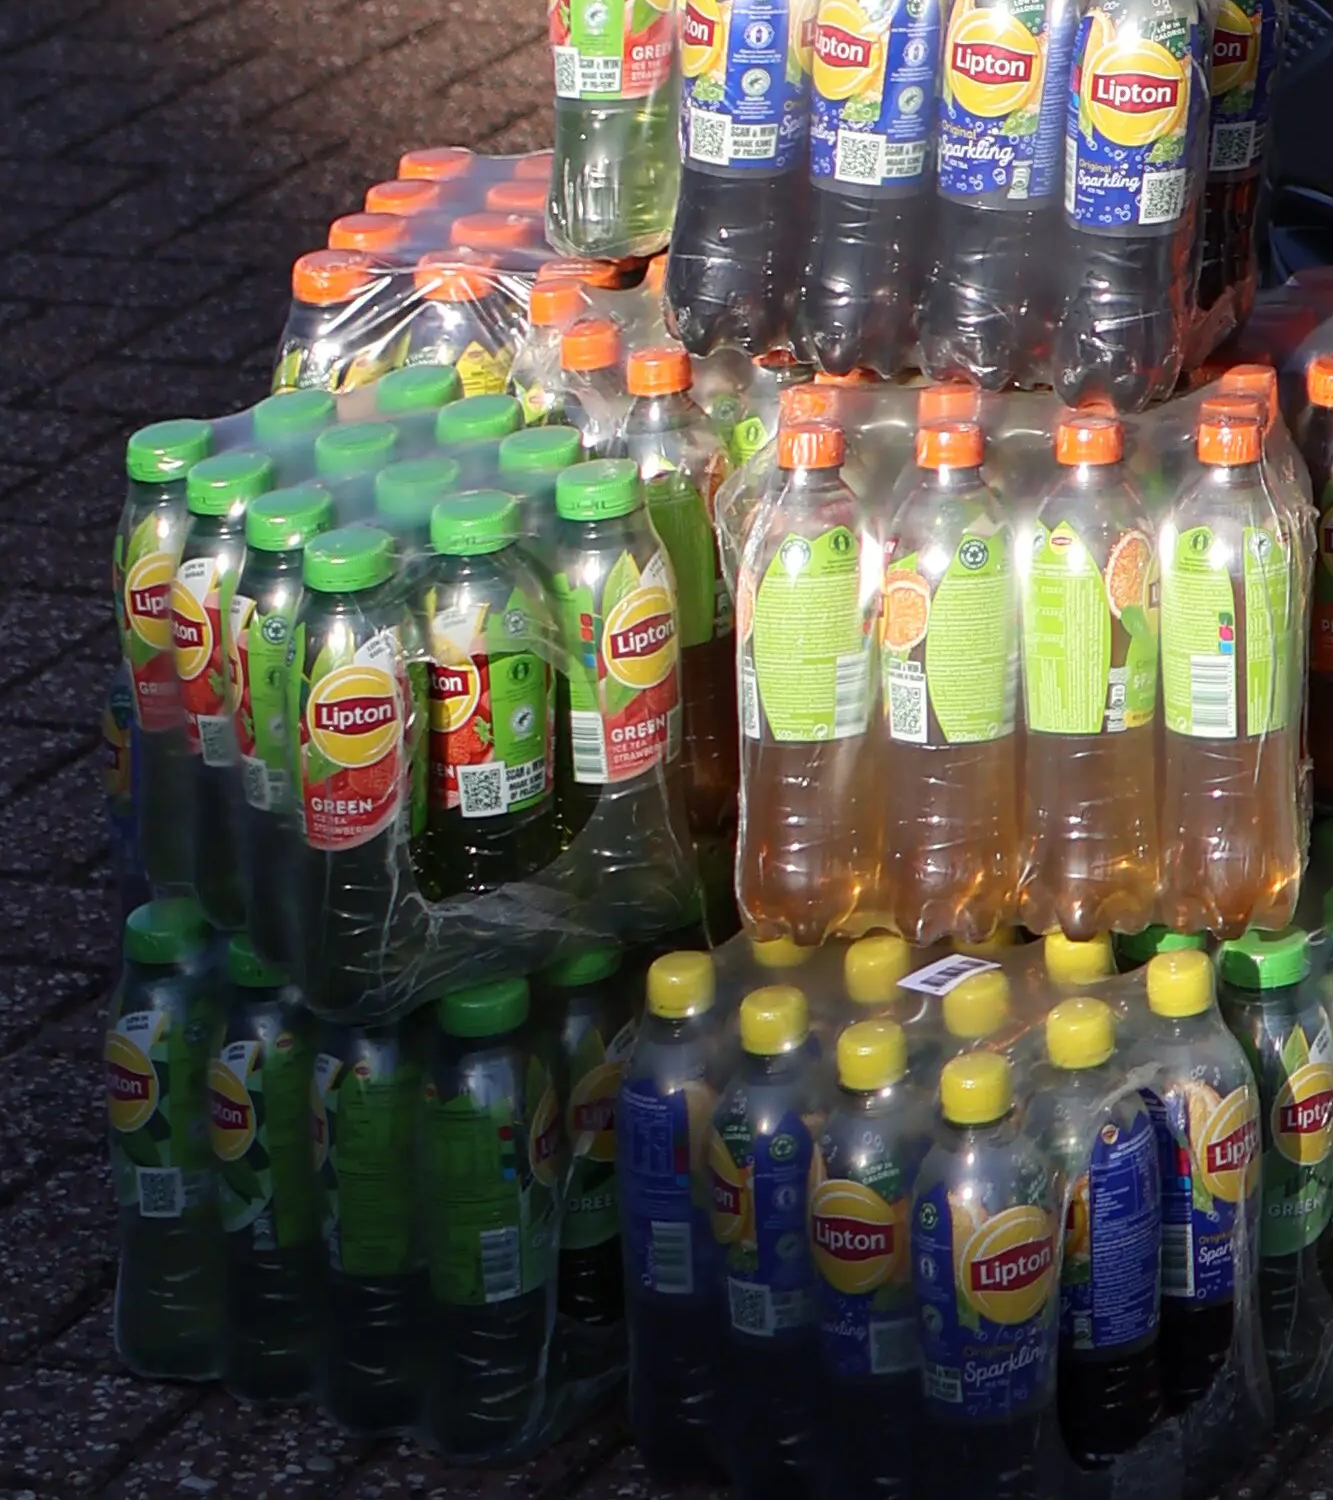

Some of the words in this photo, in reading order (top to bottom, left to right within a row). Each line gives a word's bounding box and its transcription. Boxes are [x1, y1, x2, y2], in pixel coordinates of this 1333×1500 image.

[686, 23, 708, 42] ton
[815, 27, 864, 63] Lipton
[956, 45, 1025, 79] Lipton
[1096, 78, 1172, 106] Lipton
[942, 119, 977, 140] Original
[940, 134, 1015, 167] Sparkling
[1078, 158, 1112, 174] Original
[1077, 169, 1141, 193] Sparkling
[135, 591, 167, 615] Lip
[174, 619, 198, 641] ton
[617, 617, 674, 655] Lipton
[431, 674, 463, 692] ton
[321, 702, 392, 731] Lipton
[611, 714, 666, 742] GREEN
[311, 797, 372, 815] GREEN
[815, 1220, 886, 1251] Lipton
[980, 1247, 1050, 1286] Lipton
